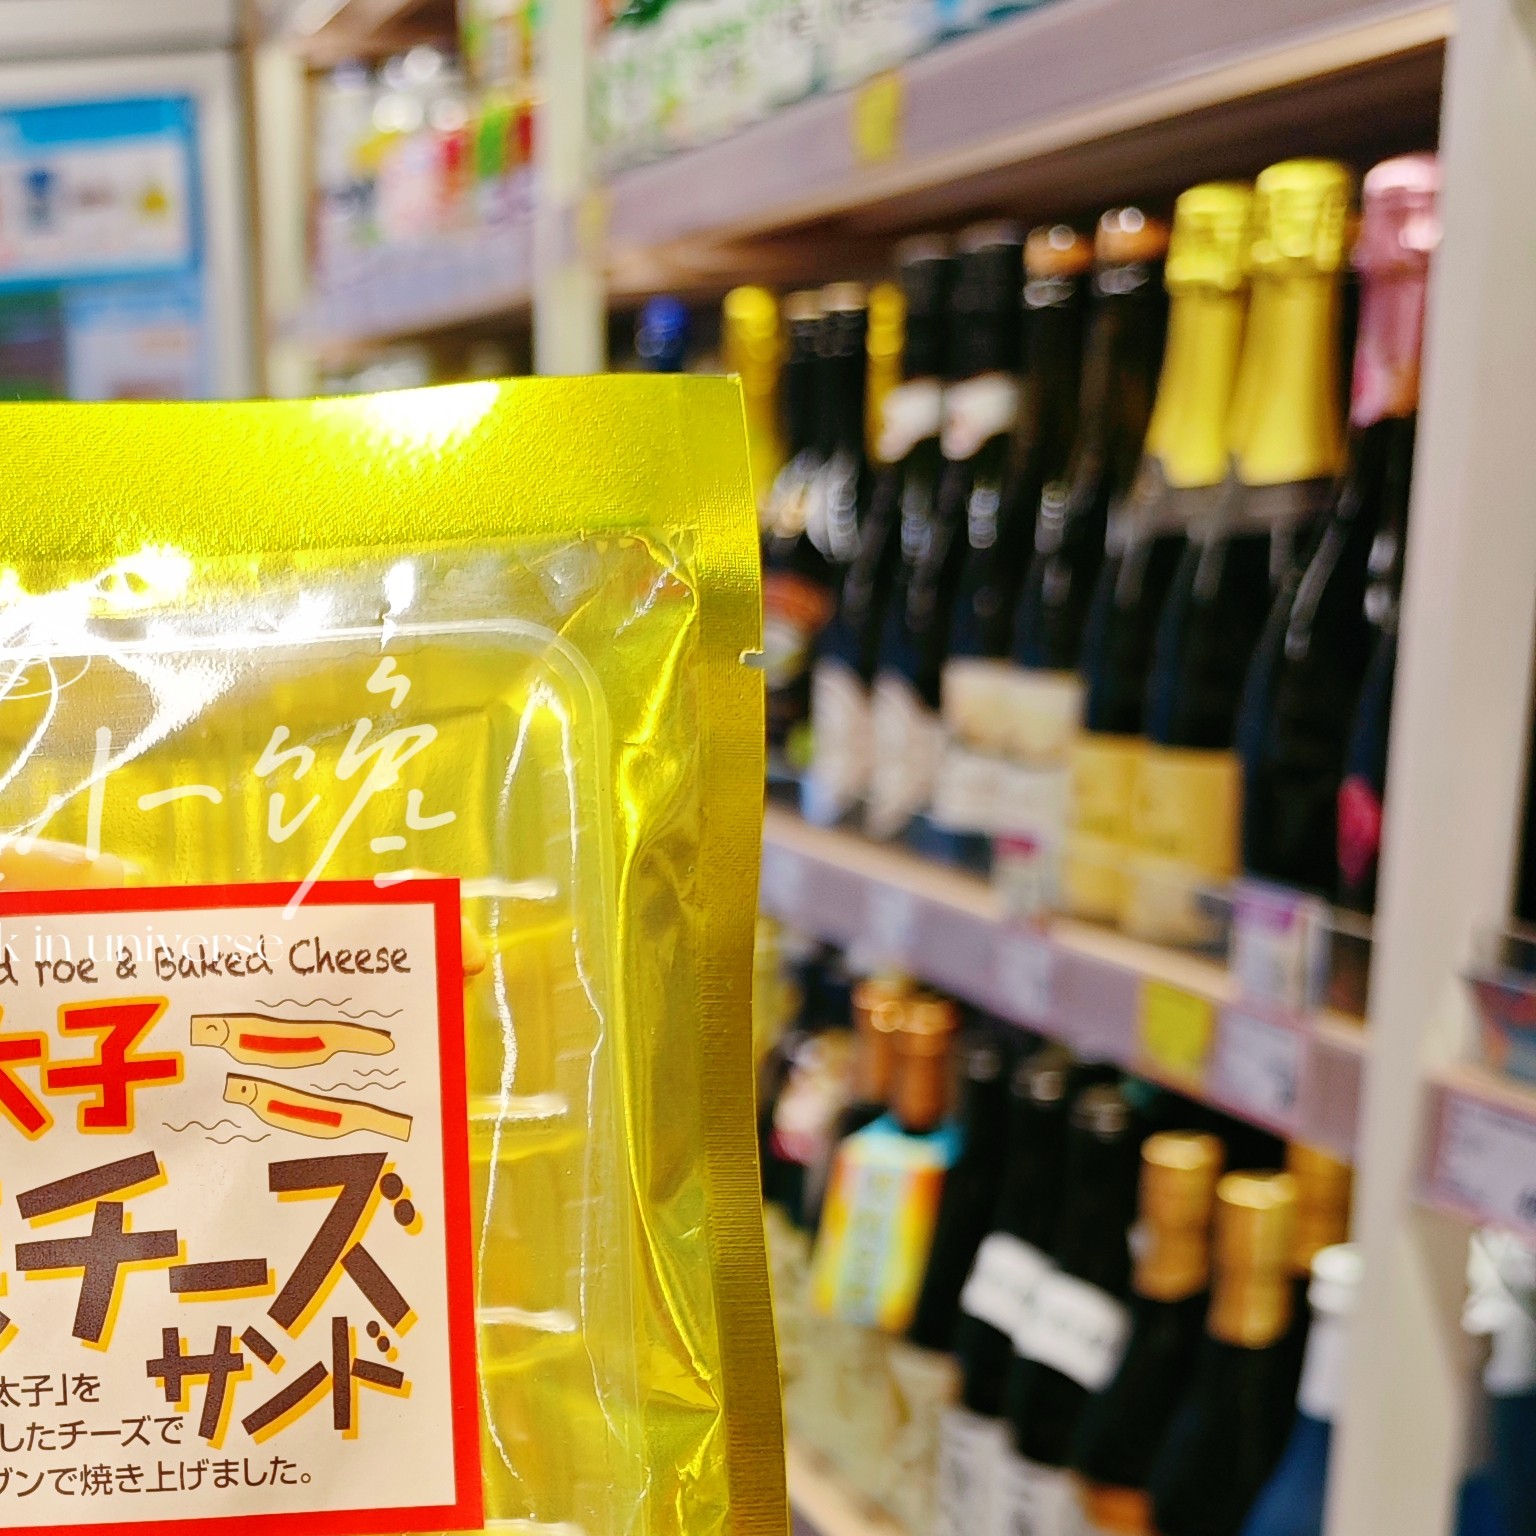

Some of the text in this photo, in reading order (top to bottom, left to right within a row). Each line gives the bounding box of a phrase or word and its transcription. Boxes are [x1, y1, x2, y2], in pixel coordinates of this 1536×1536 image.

[34, 957, 99, 988] roe
[115, 945, 138, 981] &
[154, 934, 274, 982] Baked
[288, 936, 412, 977] Cheese
[146, 1314, 413, 1451] サンド
